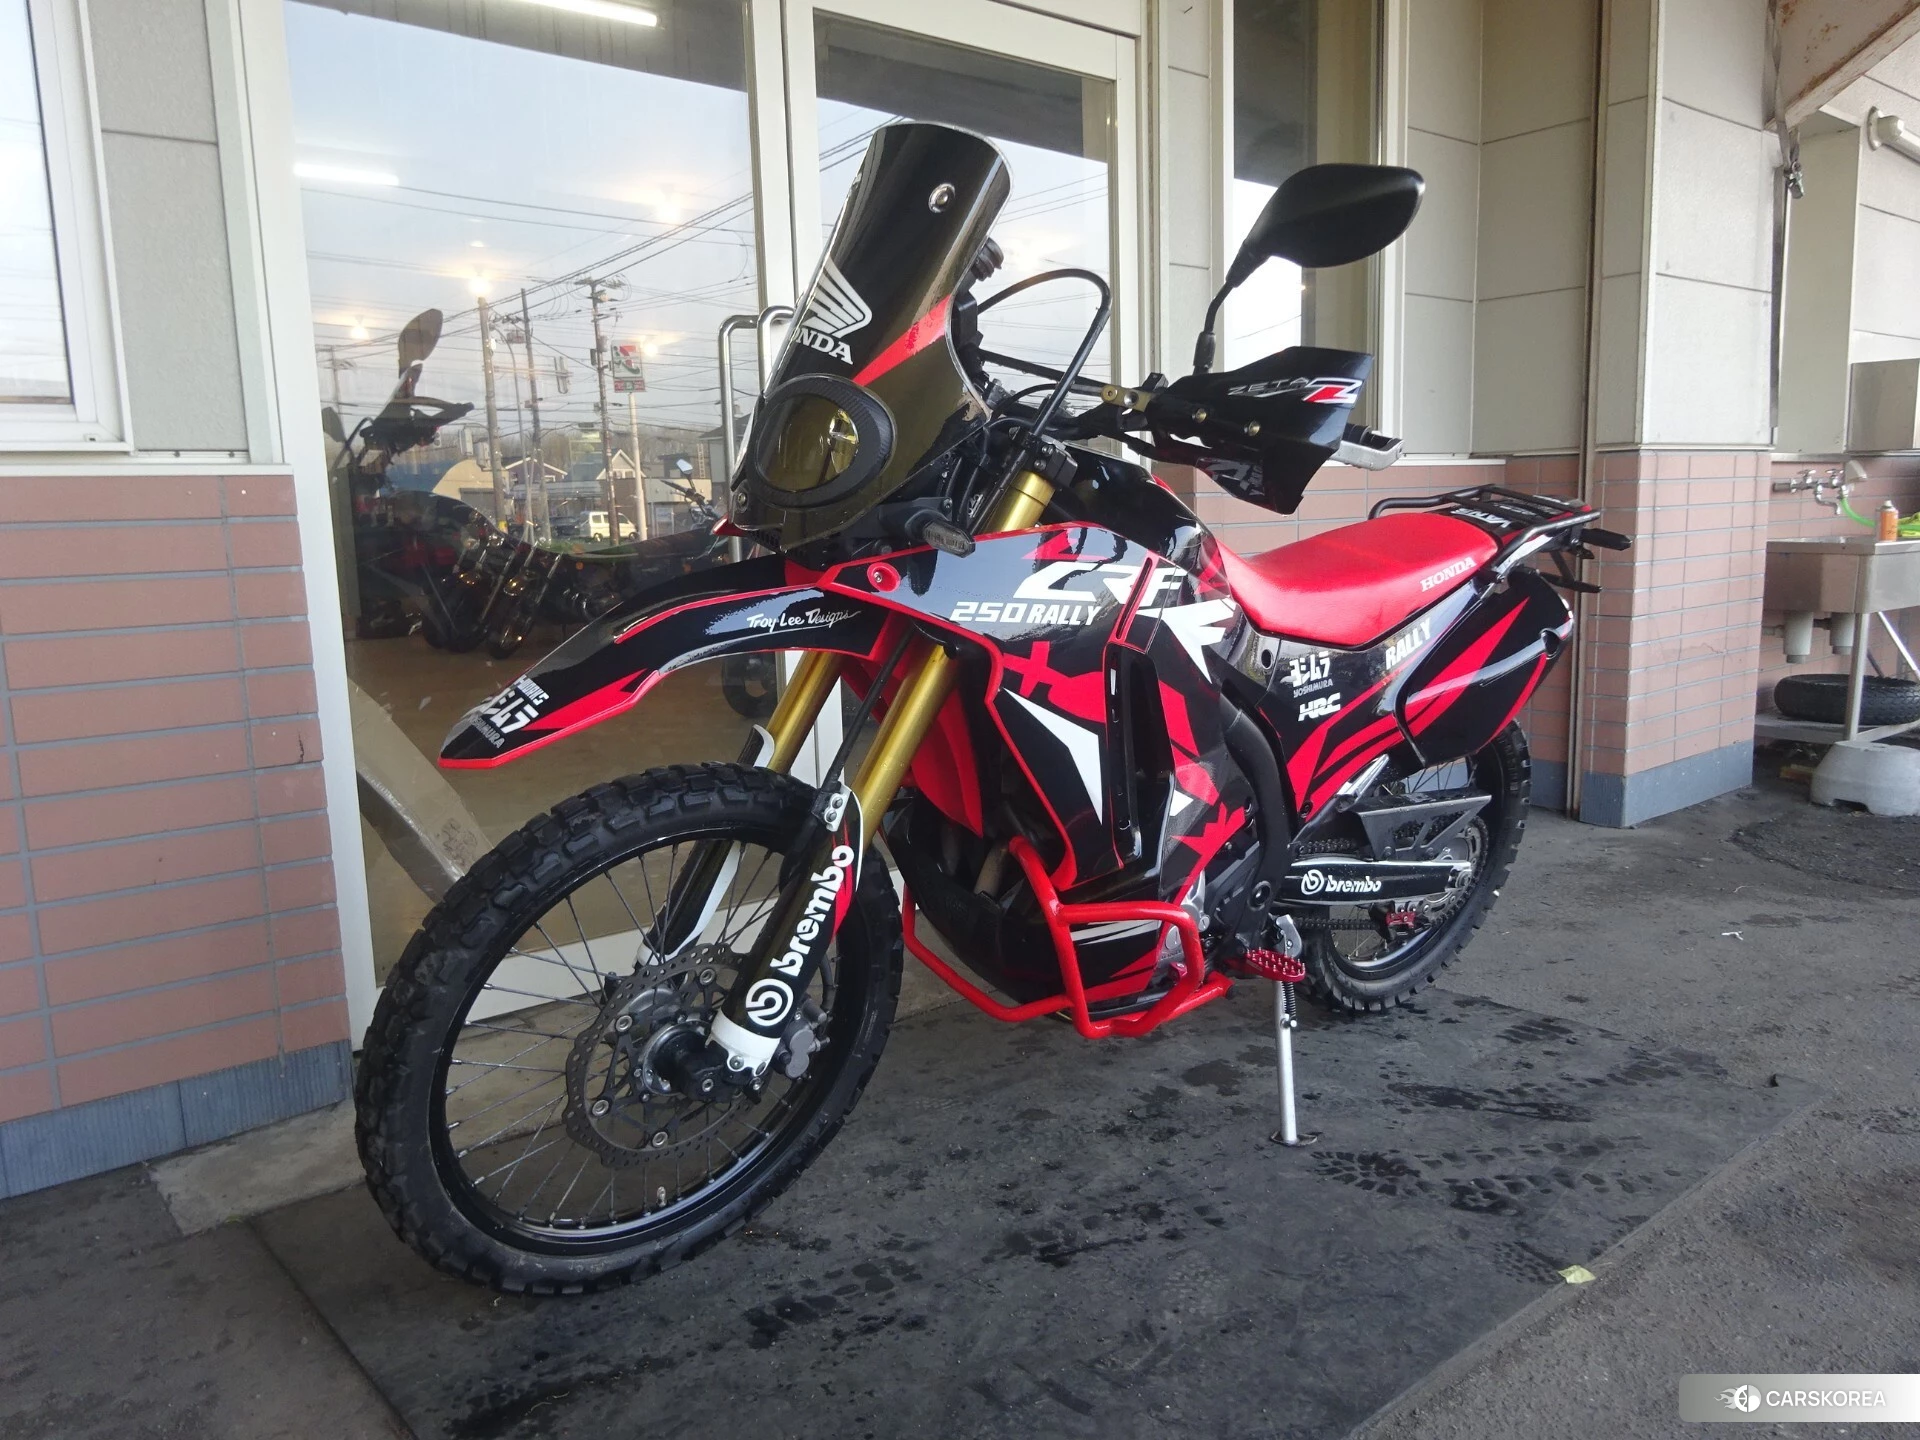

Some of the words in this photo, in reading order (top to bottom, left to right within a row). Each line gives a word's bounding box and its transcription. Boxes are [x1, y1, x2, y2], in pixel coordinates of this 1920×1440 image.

[794, 326, 854, 365] NDA
[1228, 377, 1309, 396] ZETA
[1013, 561, 1189, 606] CRF
[1420, 556, 1477, 592] HONDA
[746, 613, 778, 633] Troy
[779, 613, 805, 627] Lee
[805, 608, 861, 629] Designs
[949, 601, 1024, 623] 250
[1026, 603, 1103, 626] RALLY
[1385, 617, 1431, 670] RALLY
[1293, 678, 1333, 699] YOSHIMURA
[1298, 692, 1341, 722] HRC
[1325, 875, 1382, 893] brembo
[770, 844, 855, 977] brembo
